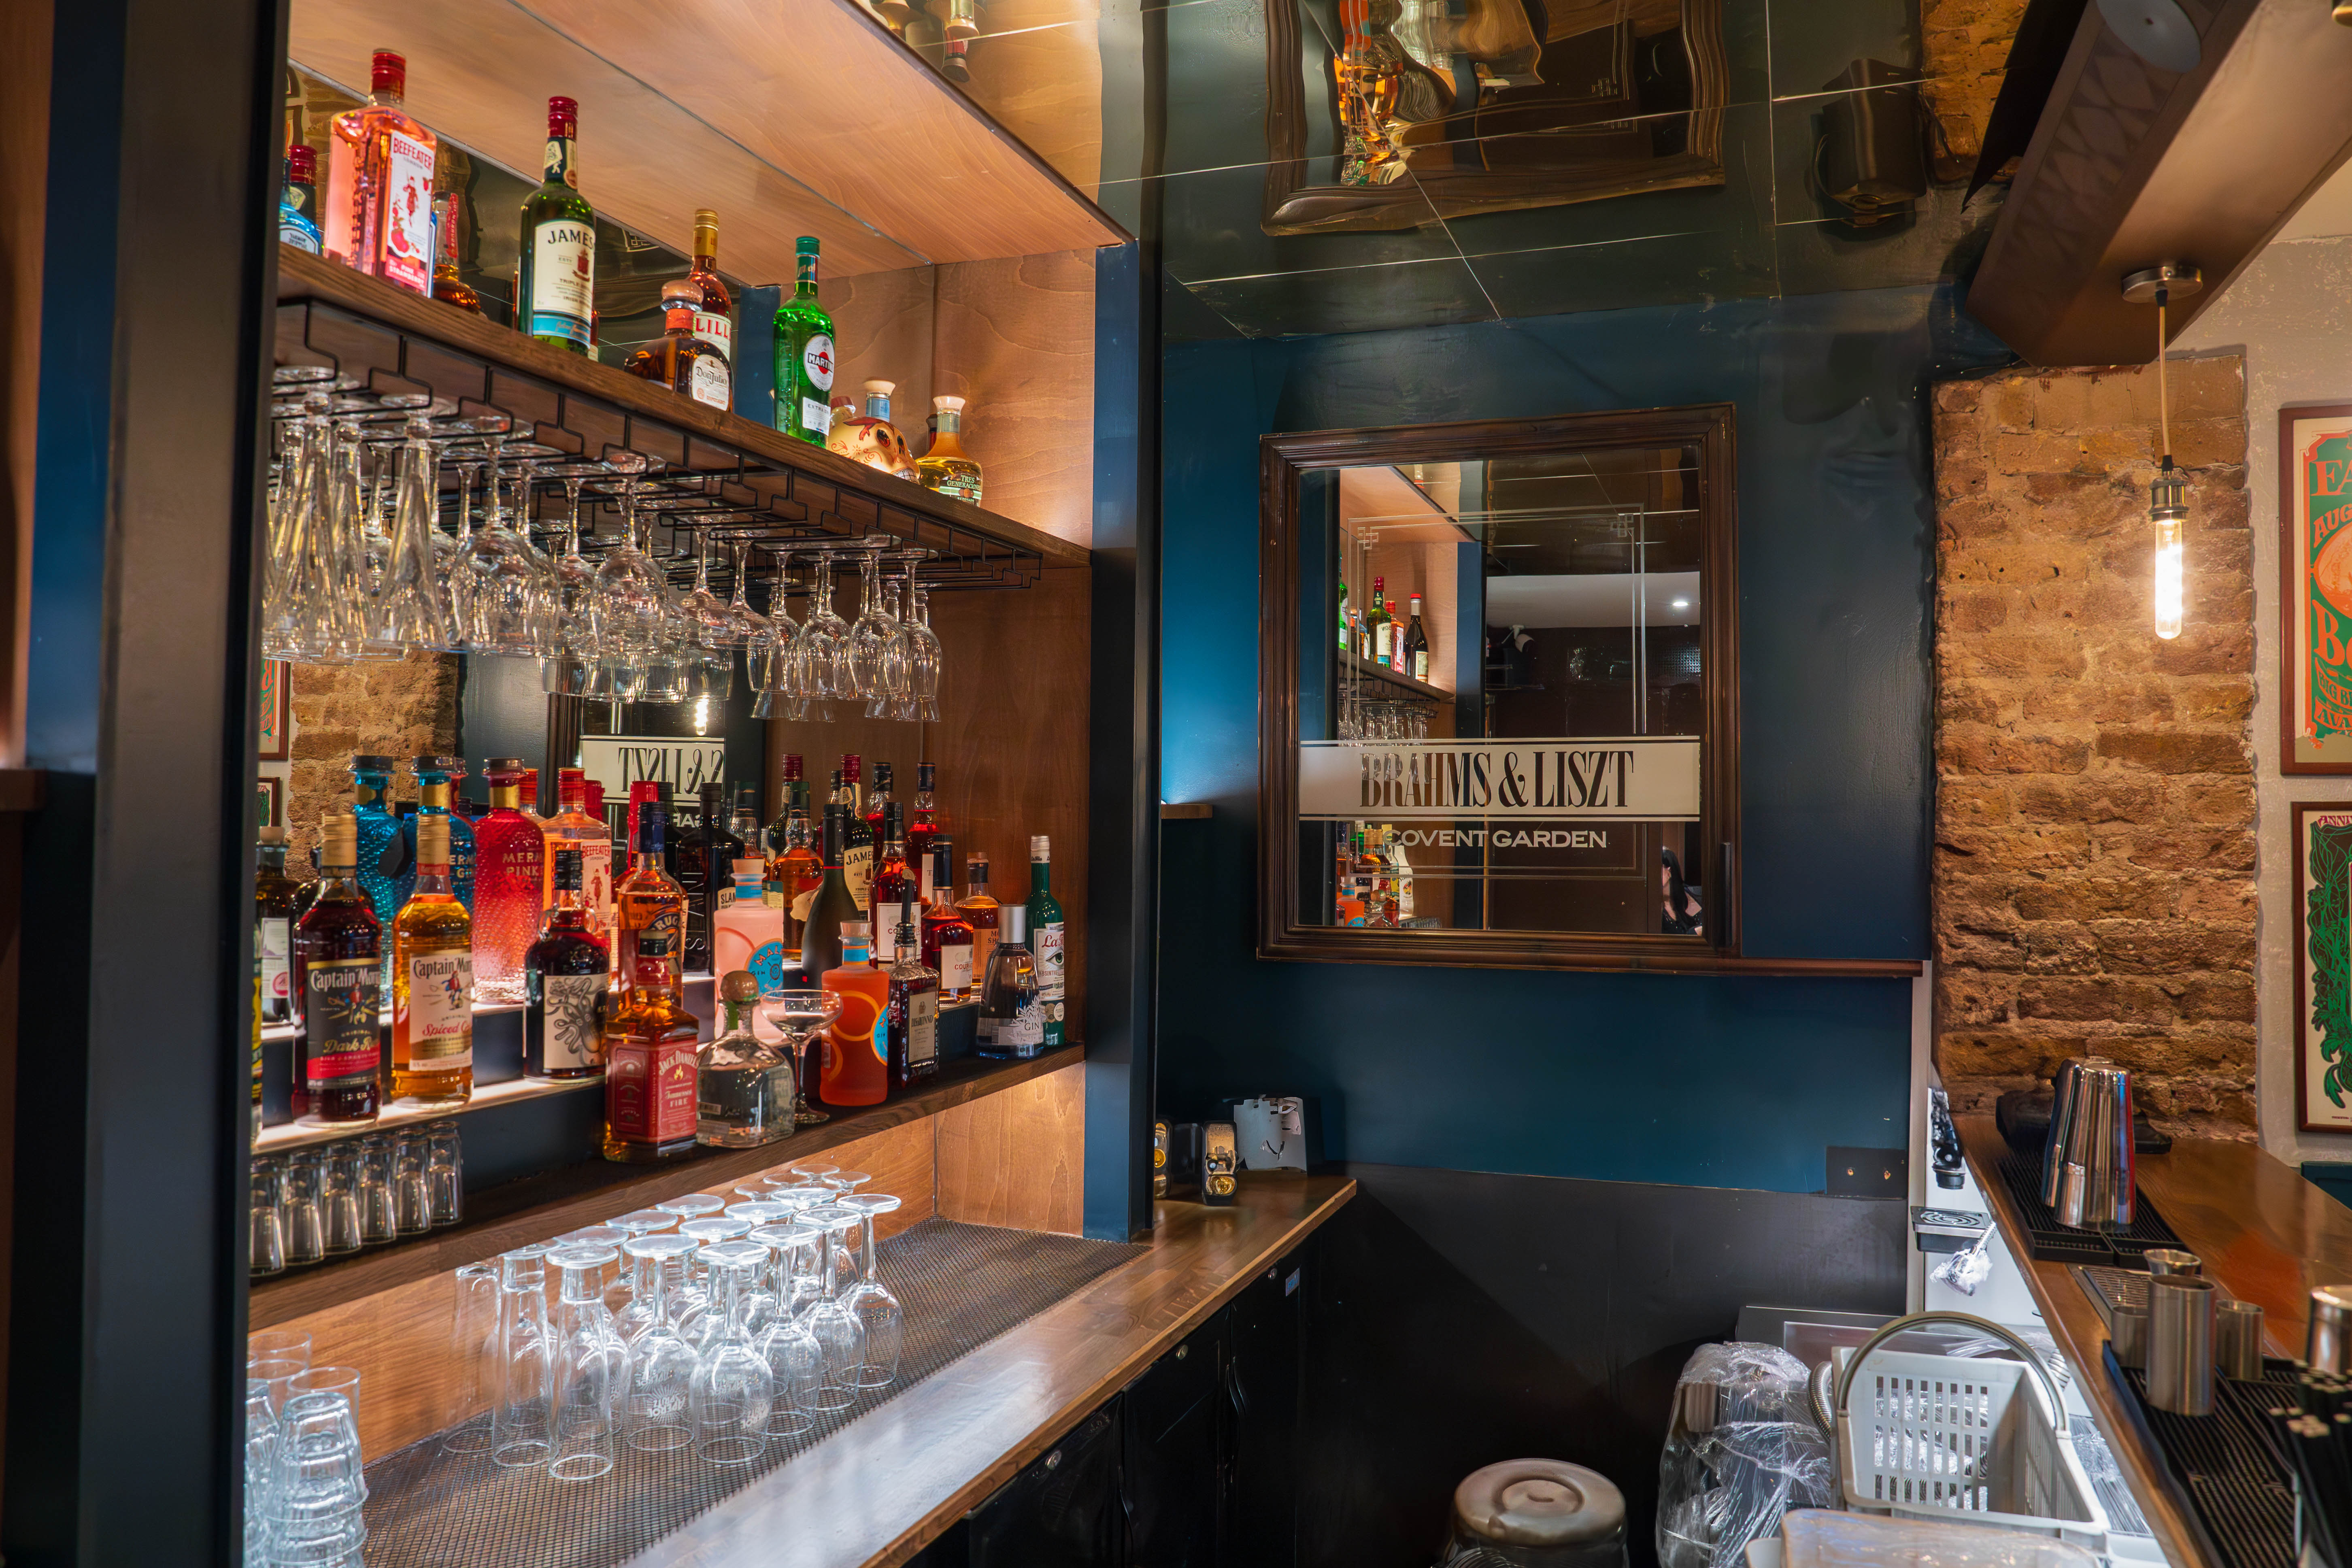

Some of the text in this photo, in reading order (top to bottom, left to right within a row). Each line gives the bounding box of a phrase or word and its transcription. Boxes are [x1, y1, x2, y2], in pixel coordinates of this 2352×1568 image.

[393, 137, 433, 172] BEEFEATER
[695, 318, 731, 341] LILL
[961, 474, 975, 484] TRES
[2312, 599, 2352, 666] B
[2318, 670, 2338, 701] BIG
[2317, 708, 2352, 729] AVA
[1359, 751, 1634, 808] BRAHMS & LISZT
[1382, 830, 1607, 848] COVENT GARDEN
[582, 845, 610, 858] BEEFEATER
[651, 915, 679, 930] RUG
[413, 958, 454, 979] Captain
[310, 968, 356, 992] Captain
[422, 1021, 460, 1036] Spiced
[1024, 1022, 1040, 1031] GIN
[323, 1037, 360, 1053] Dark
[659, 1054, 675, 1075] JACK
[670, 1098, 688, 1108] FIRE
[646, 1396, 686, 1418] APEROL
